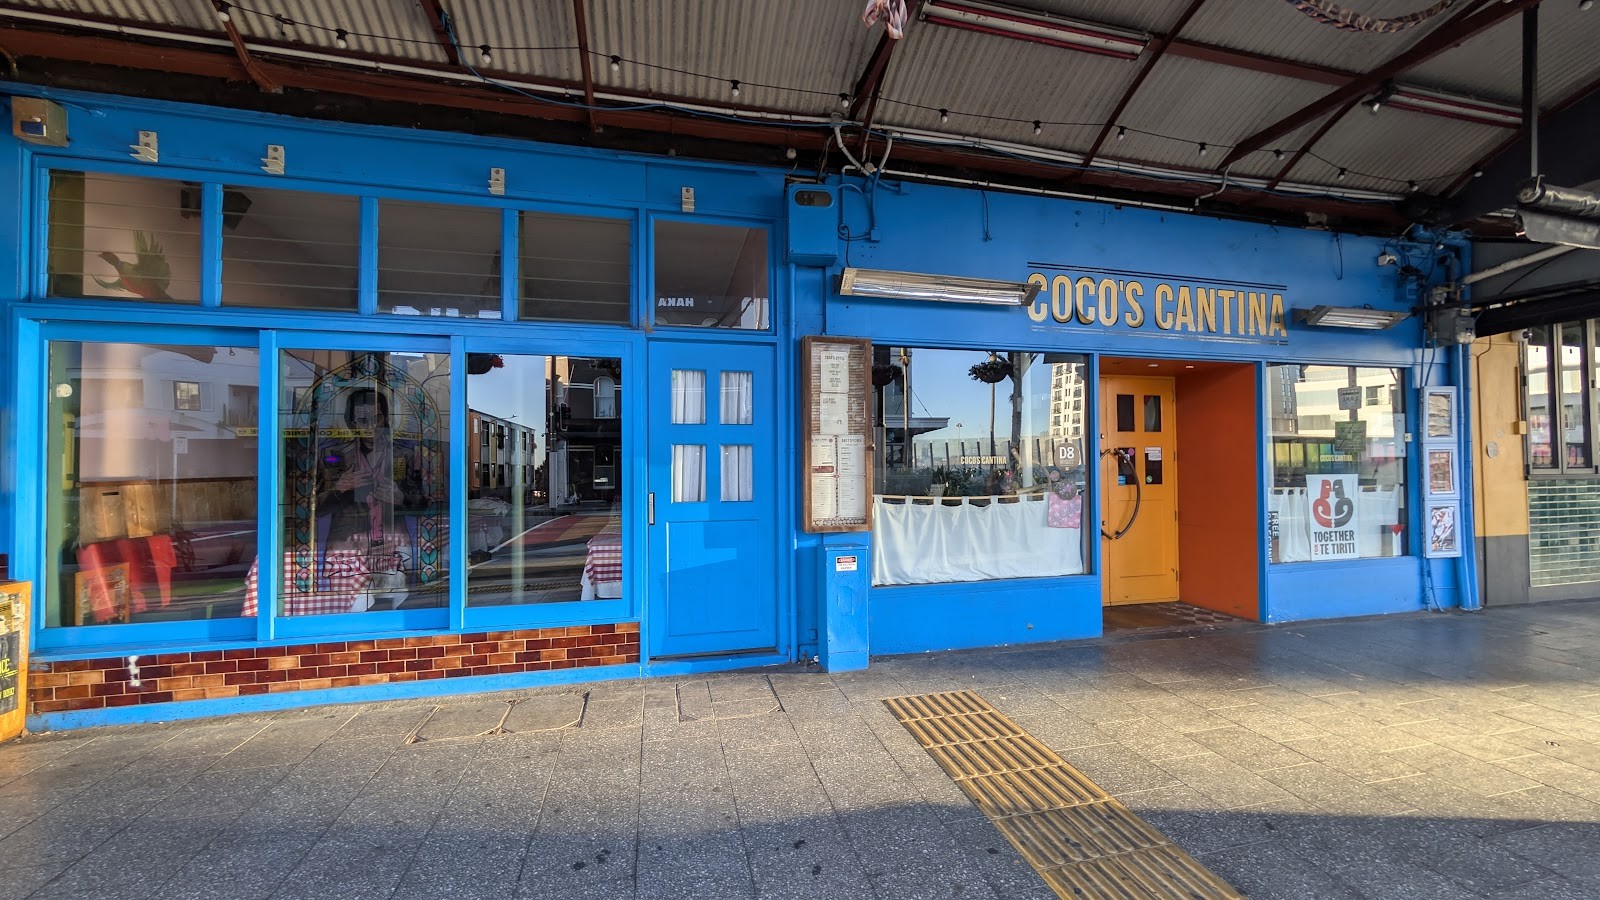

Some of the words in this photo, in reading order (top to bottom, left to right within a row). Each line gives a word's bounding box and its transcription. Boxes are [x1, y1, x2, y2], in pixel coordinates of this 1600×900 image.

[1027, 272, 1145, 328] COCO'S
[1154, 283, 1288, 338] CANTINA
[1059, 446, 1075, 459] D8
[981, 456, 1007, 465] CANTINA
[1313, 530, 1354, 543] TOGETHER
[1320, 544, 1329, 555] TE
[1332, 542, 1355, 554] TIRITI
